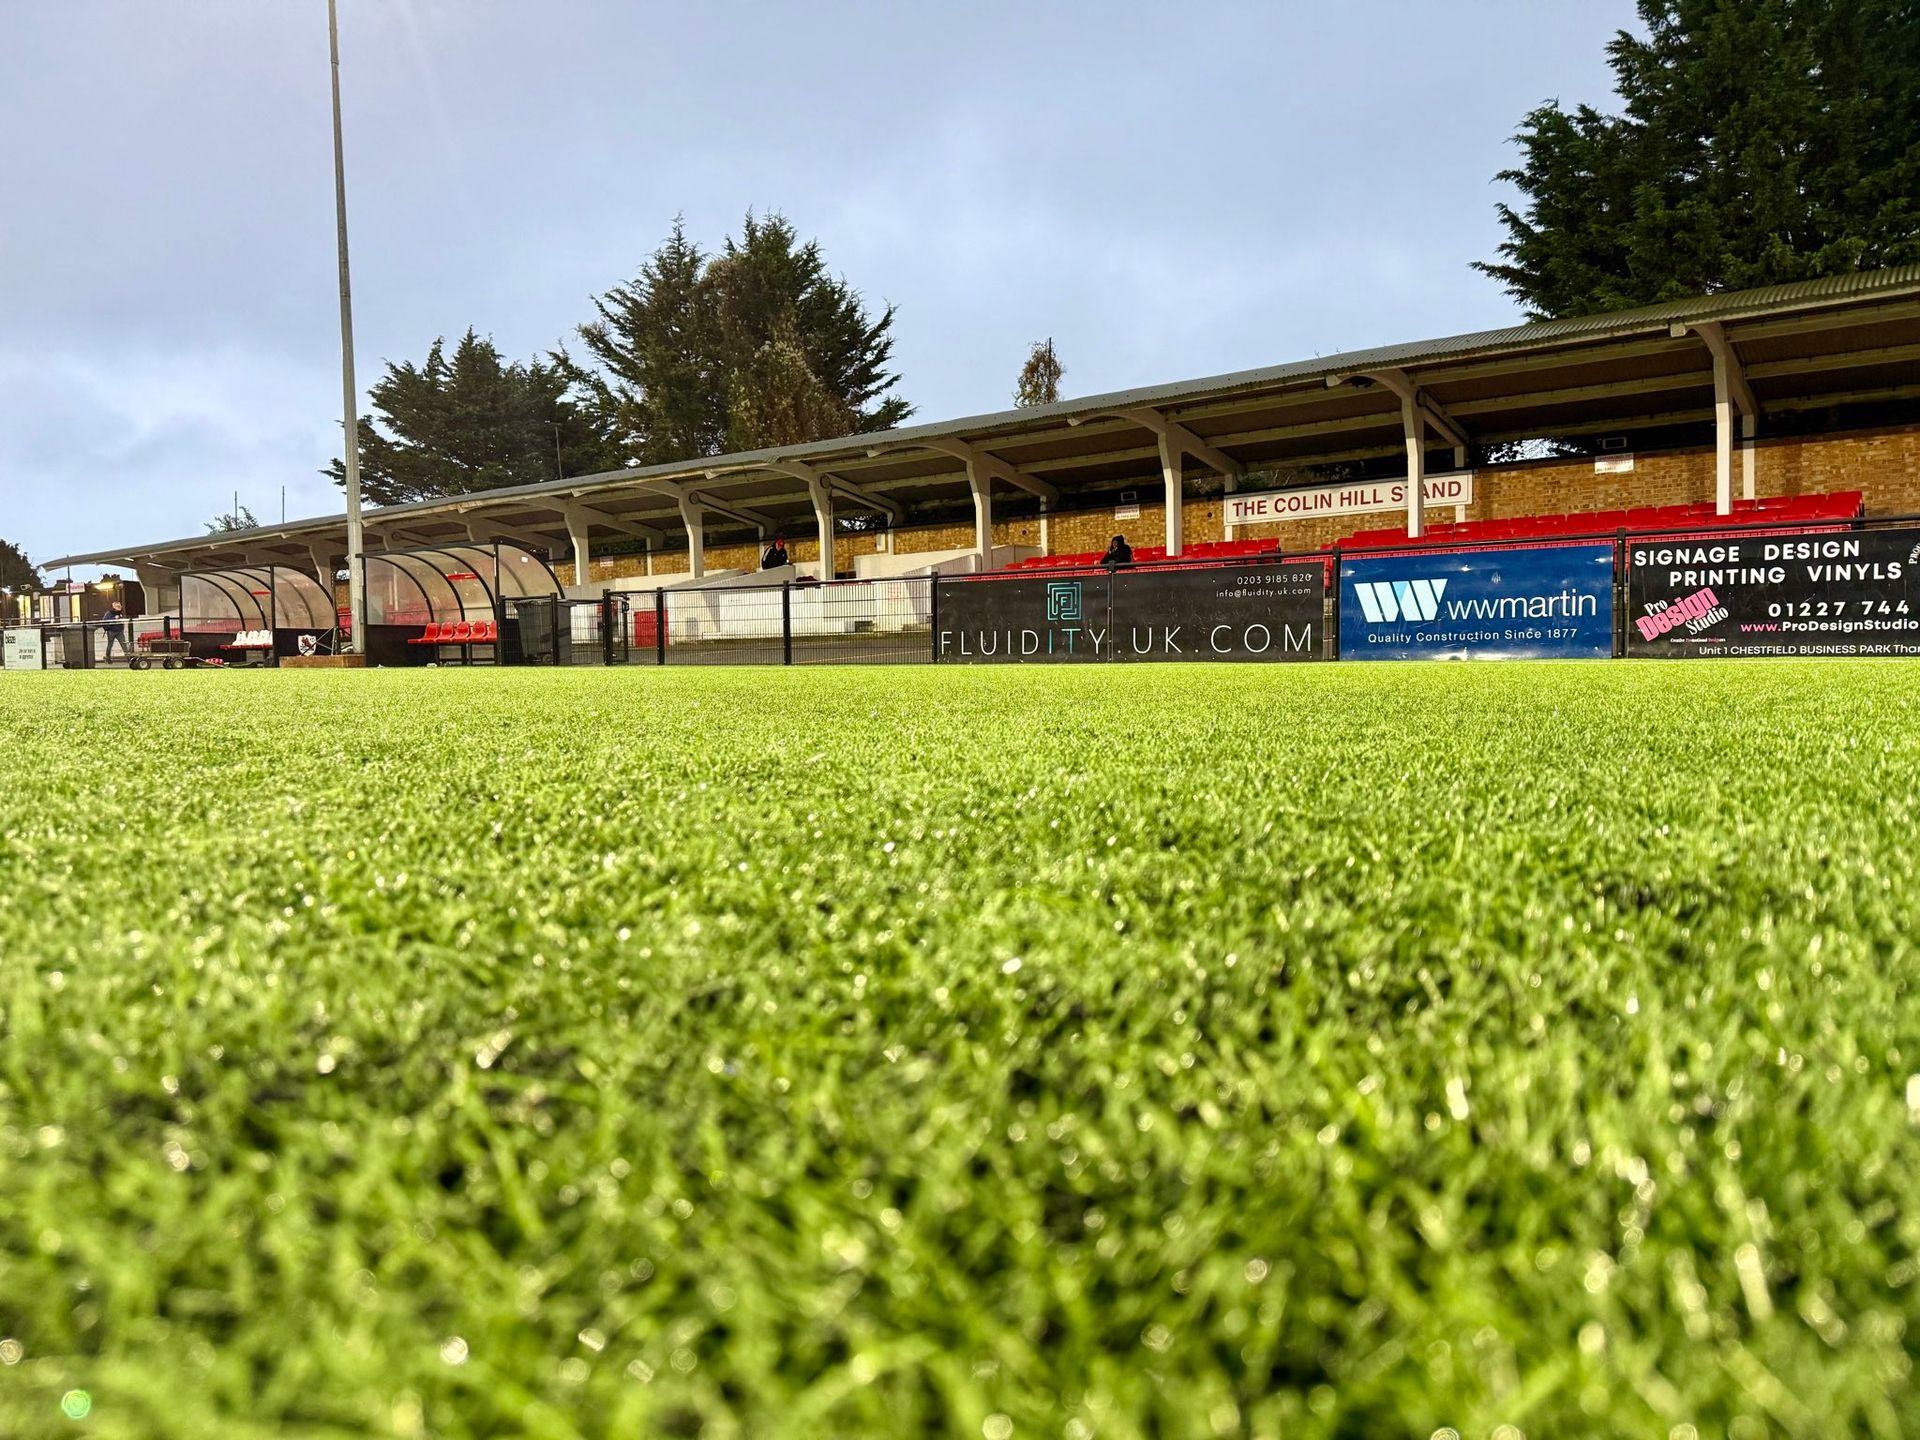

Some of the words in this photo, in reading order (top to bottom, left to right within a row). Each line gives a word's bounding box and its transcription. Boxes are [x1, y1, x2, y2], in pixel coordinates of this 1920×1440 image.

[1232, 499, 1268, 517] THE
[1274, 493, 1332, 514] COLIN
[1340, 488, 1384, 507] HILL
[1391, 480, 1462, 502] SAND
[1634, 545, 1740, 567] SIGNAGE
[1764, 540, 1860, 561] DESIGN
[1236, 576, 1262, 585] 0203
[1265, 574, 1288, 584] 9185
[1292, 573, 1313, 582] 820
[1669, 567, 1786, 587] PRINTING
[1807, 562, 1902, 582] VINYLS
[1216, 587, 1312, 598] info@fluidity.uk.com
[1447, 588, 1597, 621] wwmartin
[1643, 600, 1668, 617] Pro
[1768, 601, 1845, 617] 01227
[1861, 600, 1910, 616] 744
[1635, 587, 1720, 642] Design
[1685, 607, 1729, 635] Studio
[1740, 618, 1919, 633] www.ProDesignStudio
[1368, 633, 1412, 644] Quality
[1416, 631, 1500, 642] Construction
[1504, 629, 1542, 640] Since
[1546, 628, 1578, 639] 1877
[1699, 646, 1722, 655] Unit
[1730, 645, 1797, 655] CHESTFIELD
[1800, 645, 1857, 655] BUSINESS
[1860, 644, 1891, 654] PARK
